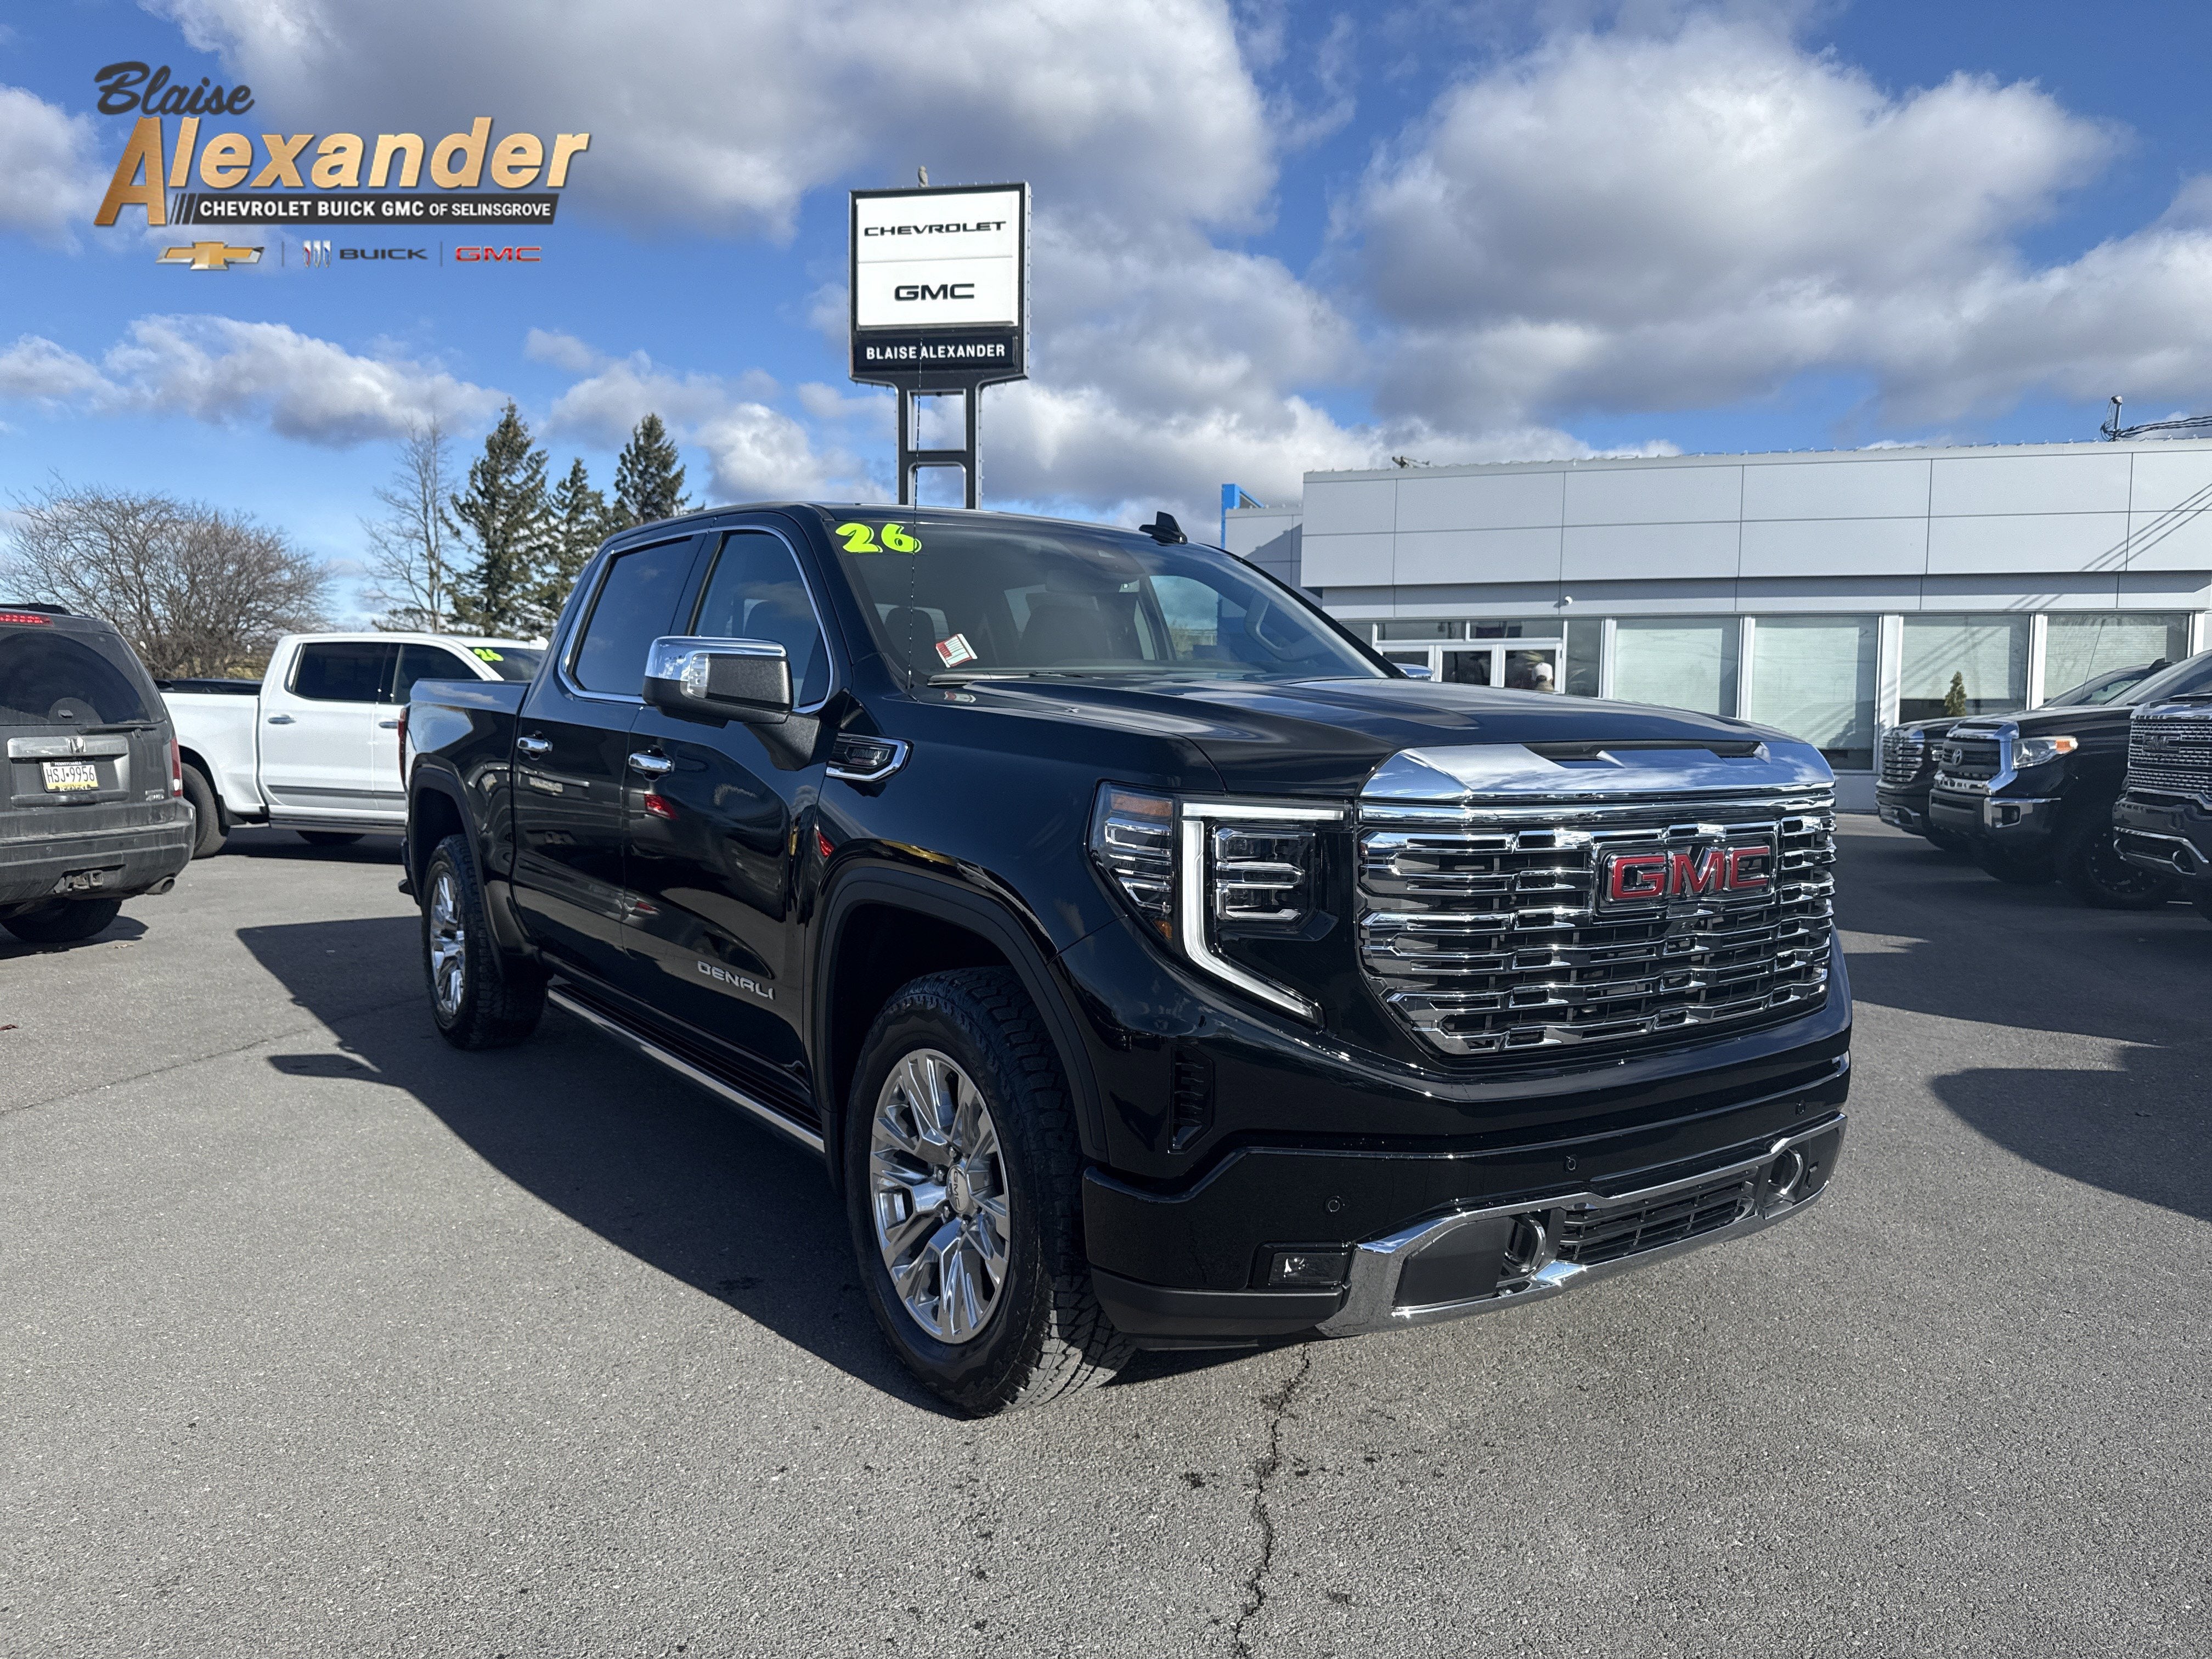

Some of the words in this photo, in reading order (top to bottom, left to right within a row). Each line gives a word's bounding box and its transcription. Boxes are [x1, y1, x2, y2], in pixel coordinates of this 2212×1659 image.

[864, 221, 1007, 237] CHEVROLET
[894, 283, 975, 302] GMC
[866, 345, 917, 360] BLAISE
[920, 343, 1006, 359] ALEXANDER
[835, 522, 922, 554] 26
[1606, 845, 1771, 901] GMC
[697, 960, 775, 1000] DENALI
